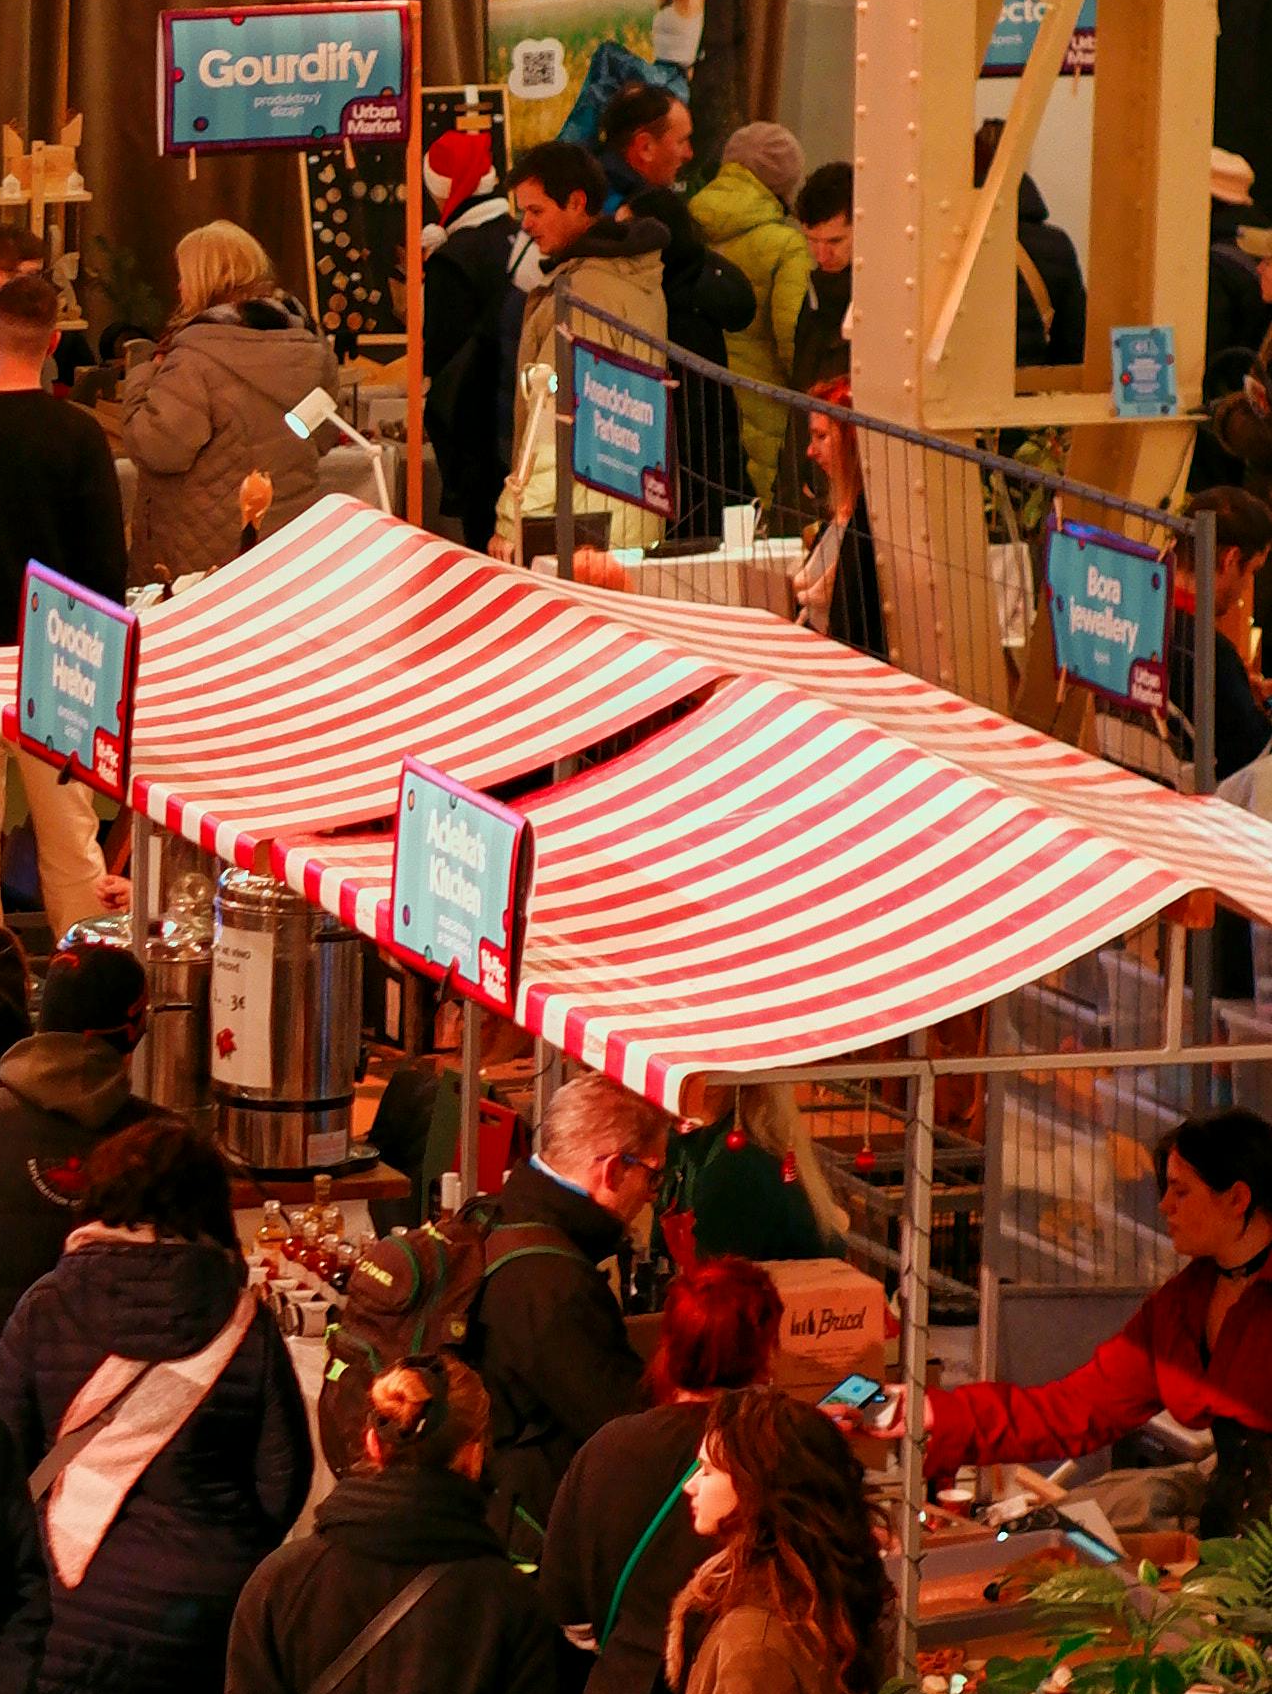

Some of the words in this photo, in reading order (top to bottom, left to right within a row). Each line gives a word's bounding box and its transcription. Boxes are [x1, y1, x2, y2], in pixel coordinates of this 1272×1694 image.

[198, 41, 379, 88] Gourdify
[347, 118, 402, 135] Market
[351, 103, 398, 120] Urban
[1087, 565, 1122, 605] Bora
[1069, 595, 1140, 655] jewellery
[52, 653, 96, 707] Hrehor
[429, 854, 481, 919] Kitchen
[230, 994, 247, 1012] 3€
